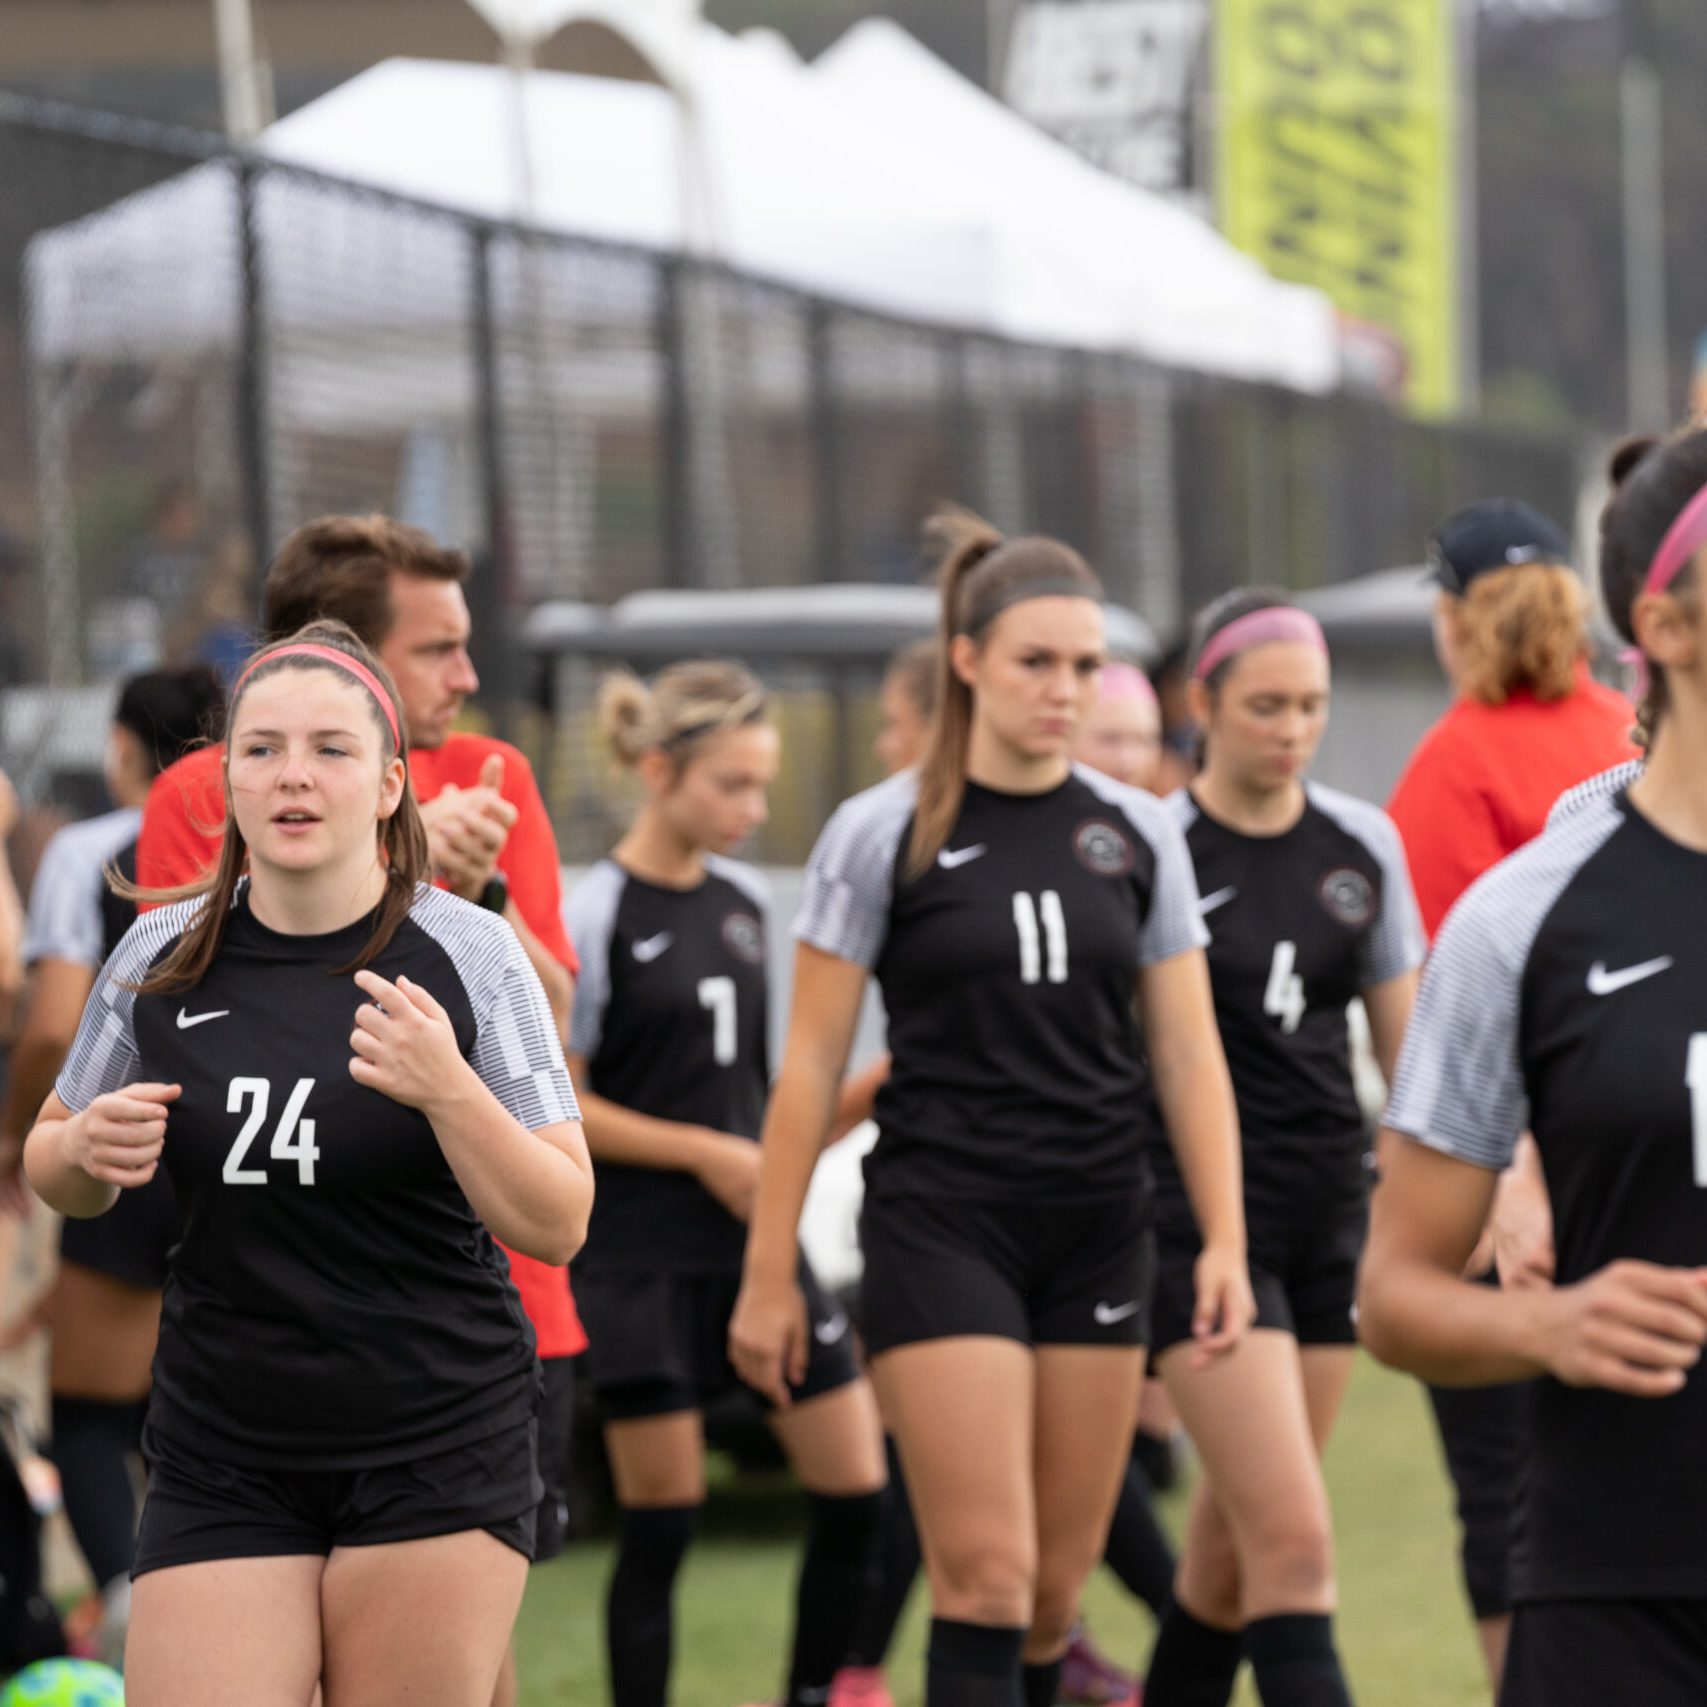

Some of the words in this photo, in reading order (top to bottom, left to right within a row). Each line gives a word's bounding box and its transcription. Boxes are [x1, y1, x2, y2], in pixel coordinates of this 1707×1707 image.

[1012, 890, 1068, 983] 11
[1264, 940, 1305, 1033] 4
[222, 1076, 320, 1185] 24
